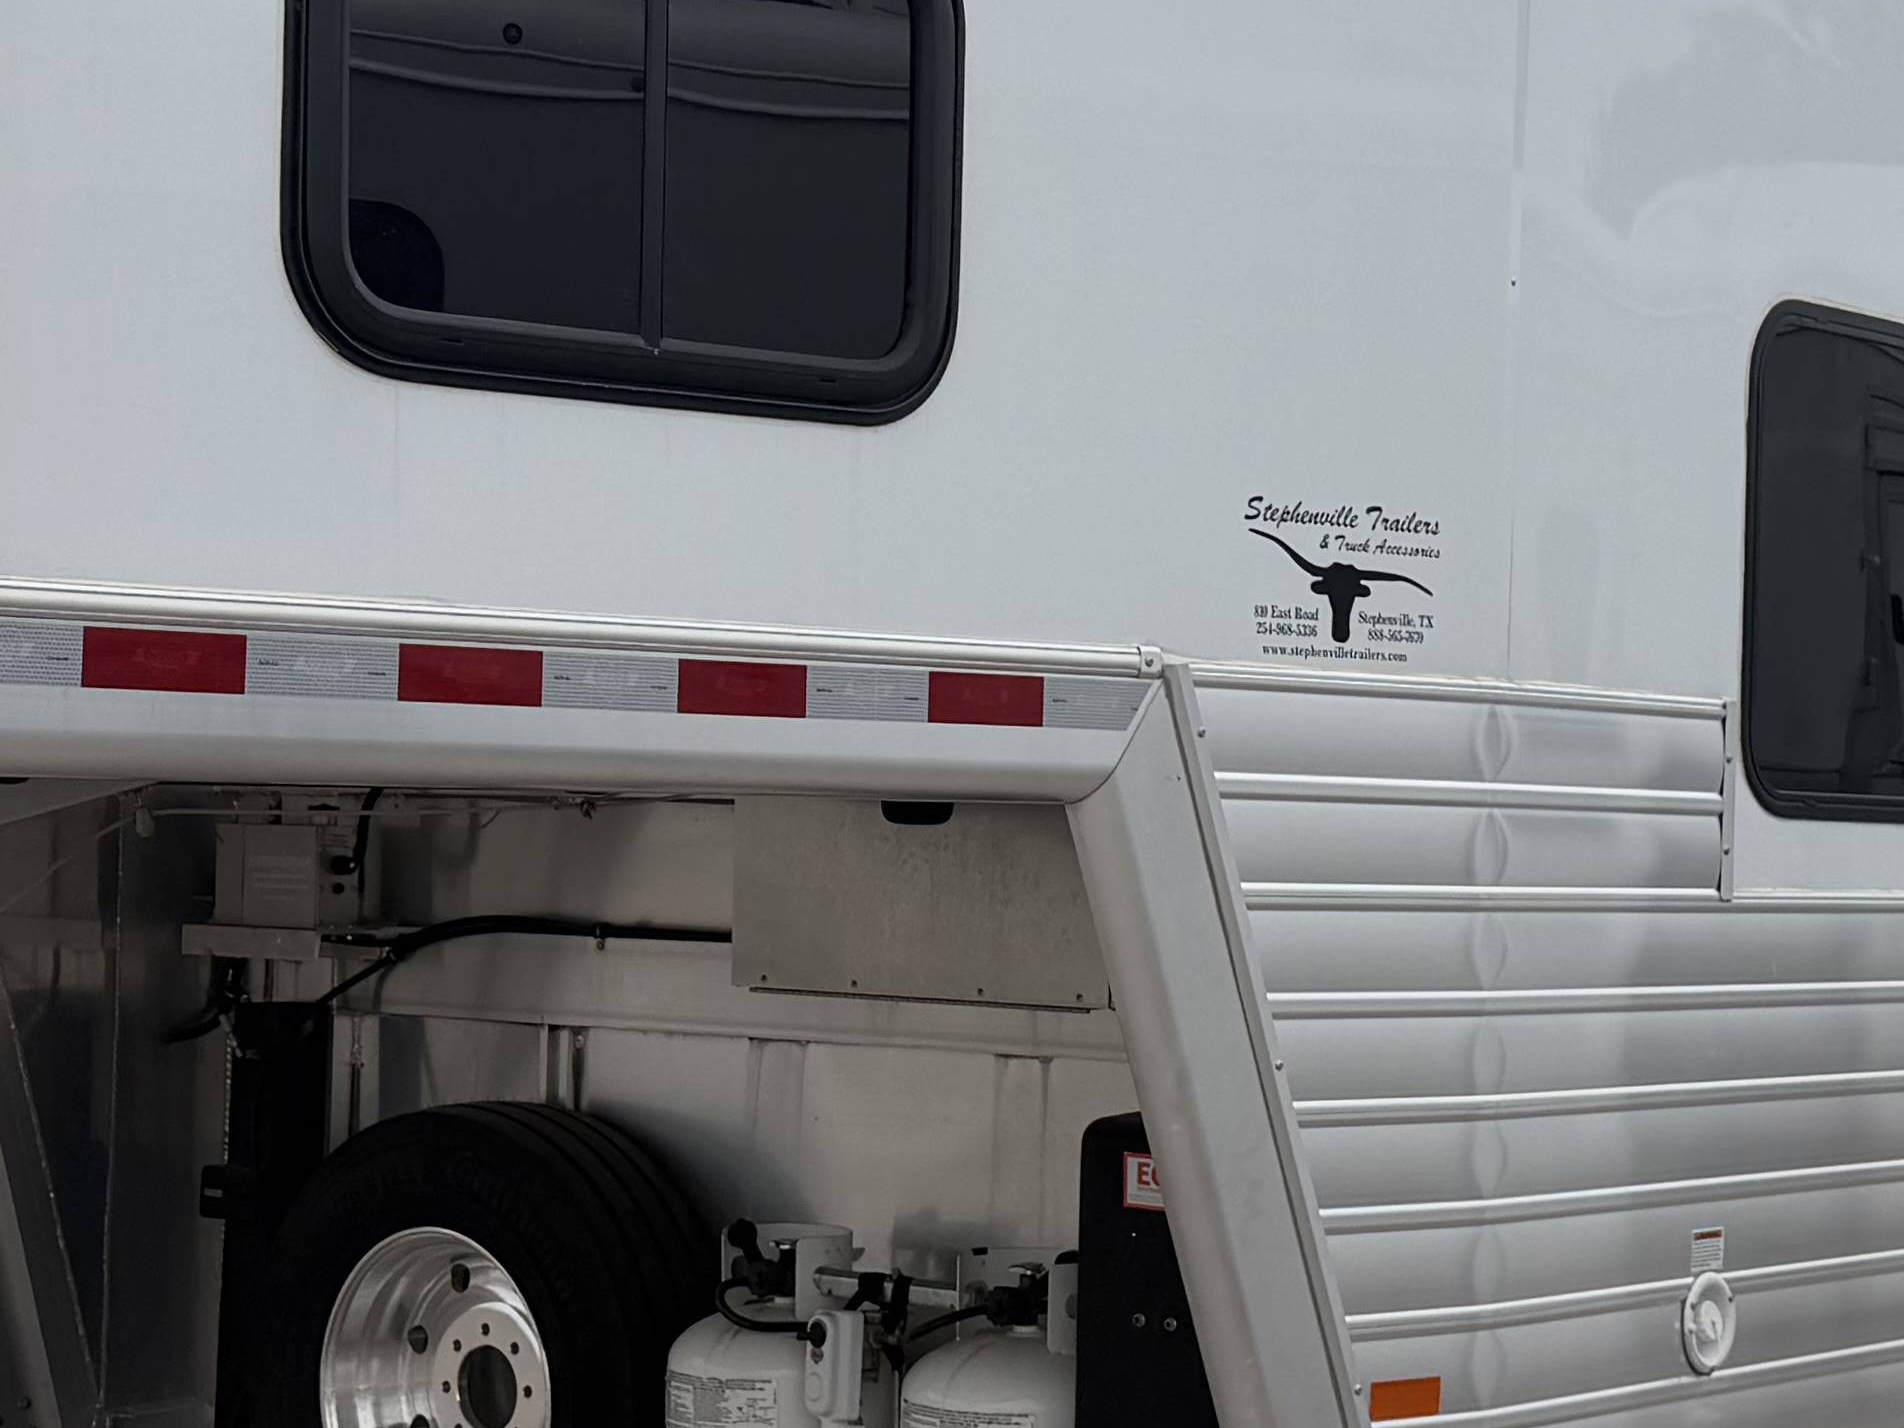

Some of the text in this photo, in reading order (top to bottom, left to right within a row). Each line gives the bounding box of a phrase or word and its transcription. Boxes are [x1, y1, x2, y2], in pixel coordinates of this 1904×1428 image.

[1244, 496, 1441, 535] Stephenville Trailers
[1319, 534, 1441, 559] & Truck Accessories
[1271, 605, 1292, 621] East
[1418, 615, 1434, 629] TX
